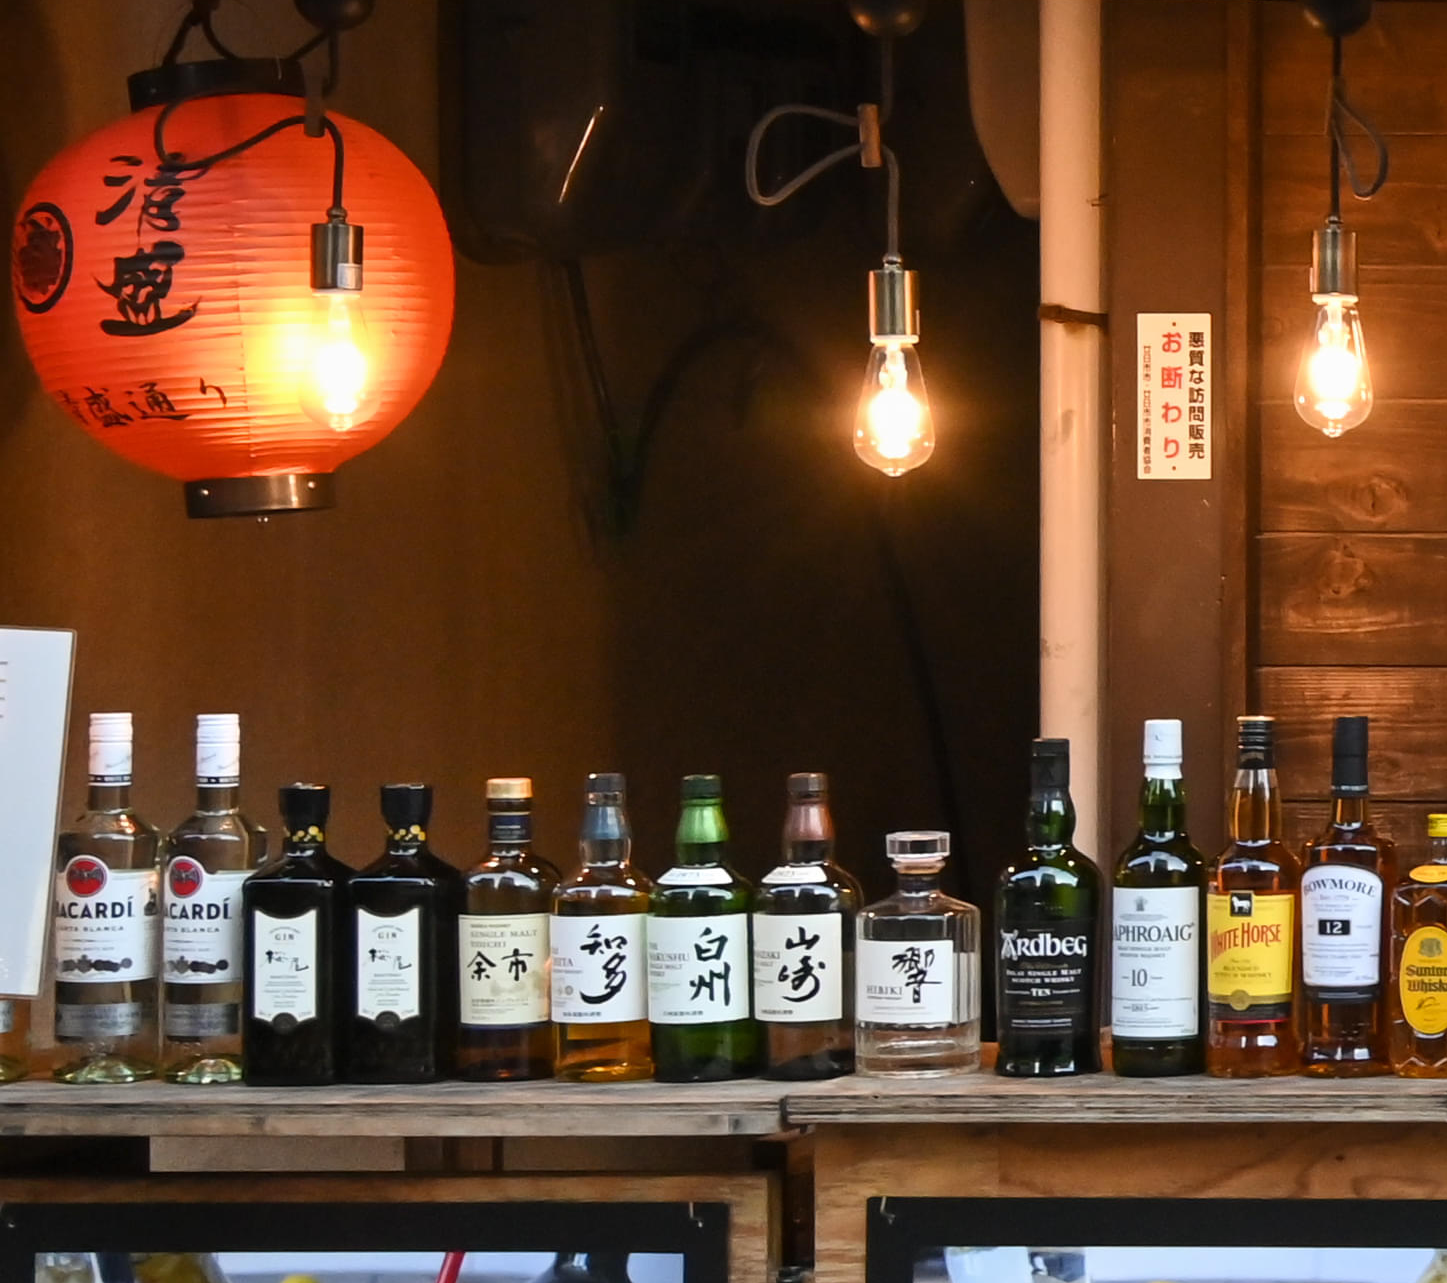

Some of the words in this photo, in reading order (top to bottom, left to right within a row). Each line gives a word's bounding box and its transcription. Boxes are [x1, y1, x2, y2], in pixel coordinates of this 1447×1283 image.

[1161, 331, 1183, 459] お断わり
[1188, 331, 1205, 460] 悪質な訪問販売
[1303, 877, 1377, 898] BOWMORE
[56, 896, 134, 919] ACARDÍ
[164, 897, 232, 920] CARDÍ
[274, 932, 295, 942] GIN
[377, 930, 398, 940] GIN
[1113, 923, 1193, 943] APHROAIG
[1241, 921, 1282, 949] HORSE
[1325, 920, 1343, 935] 12
[466, 947, 535, 983] 余市
[579, 923, 628, 1006] 知多
[689, 926, 732, 1007] 白州
[1131, 968, 1148, 987] 10
[866, 984, 903, 996] HIBIKI
[1030, 987, 1051, 997] TEN
